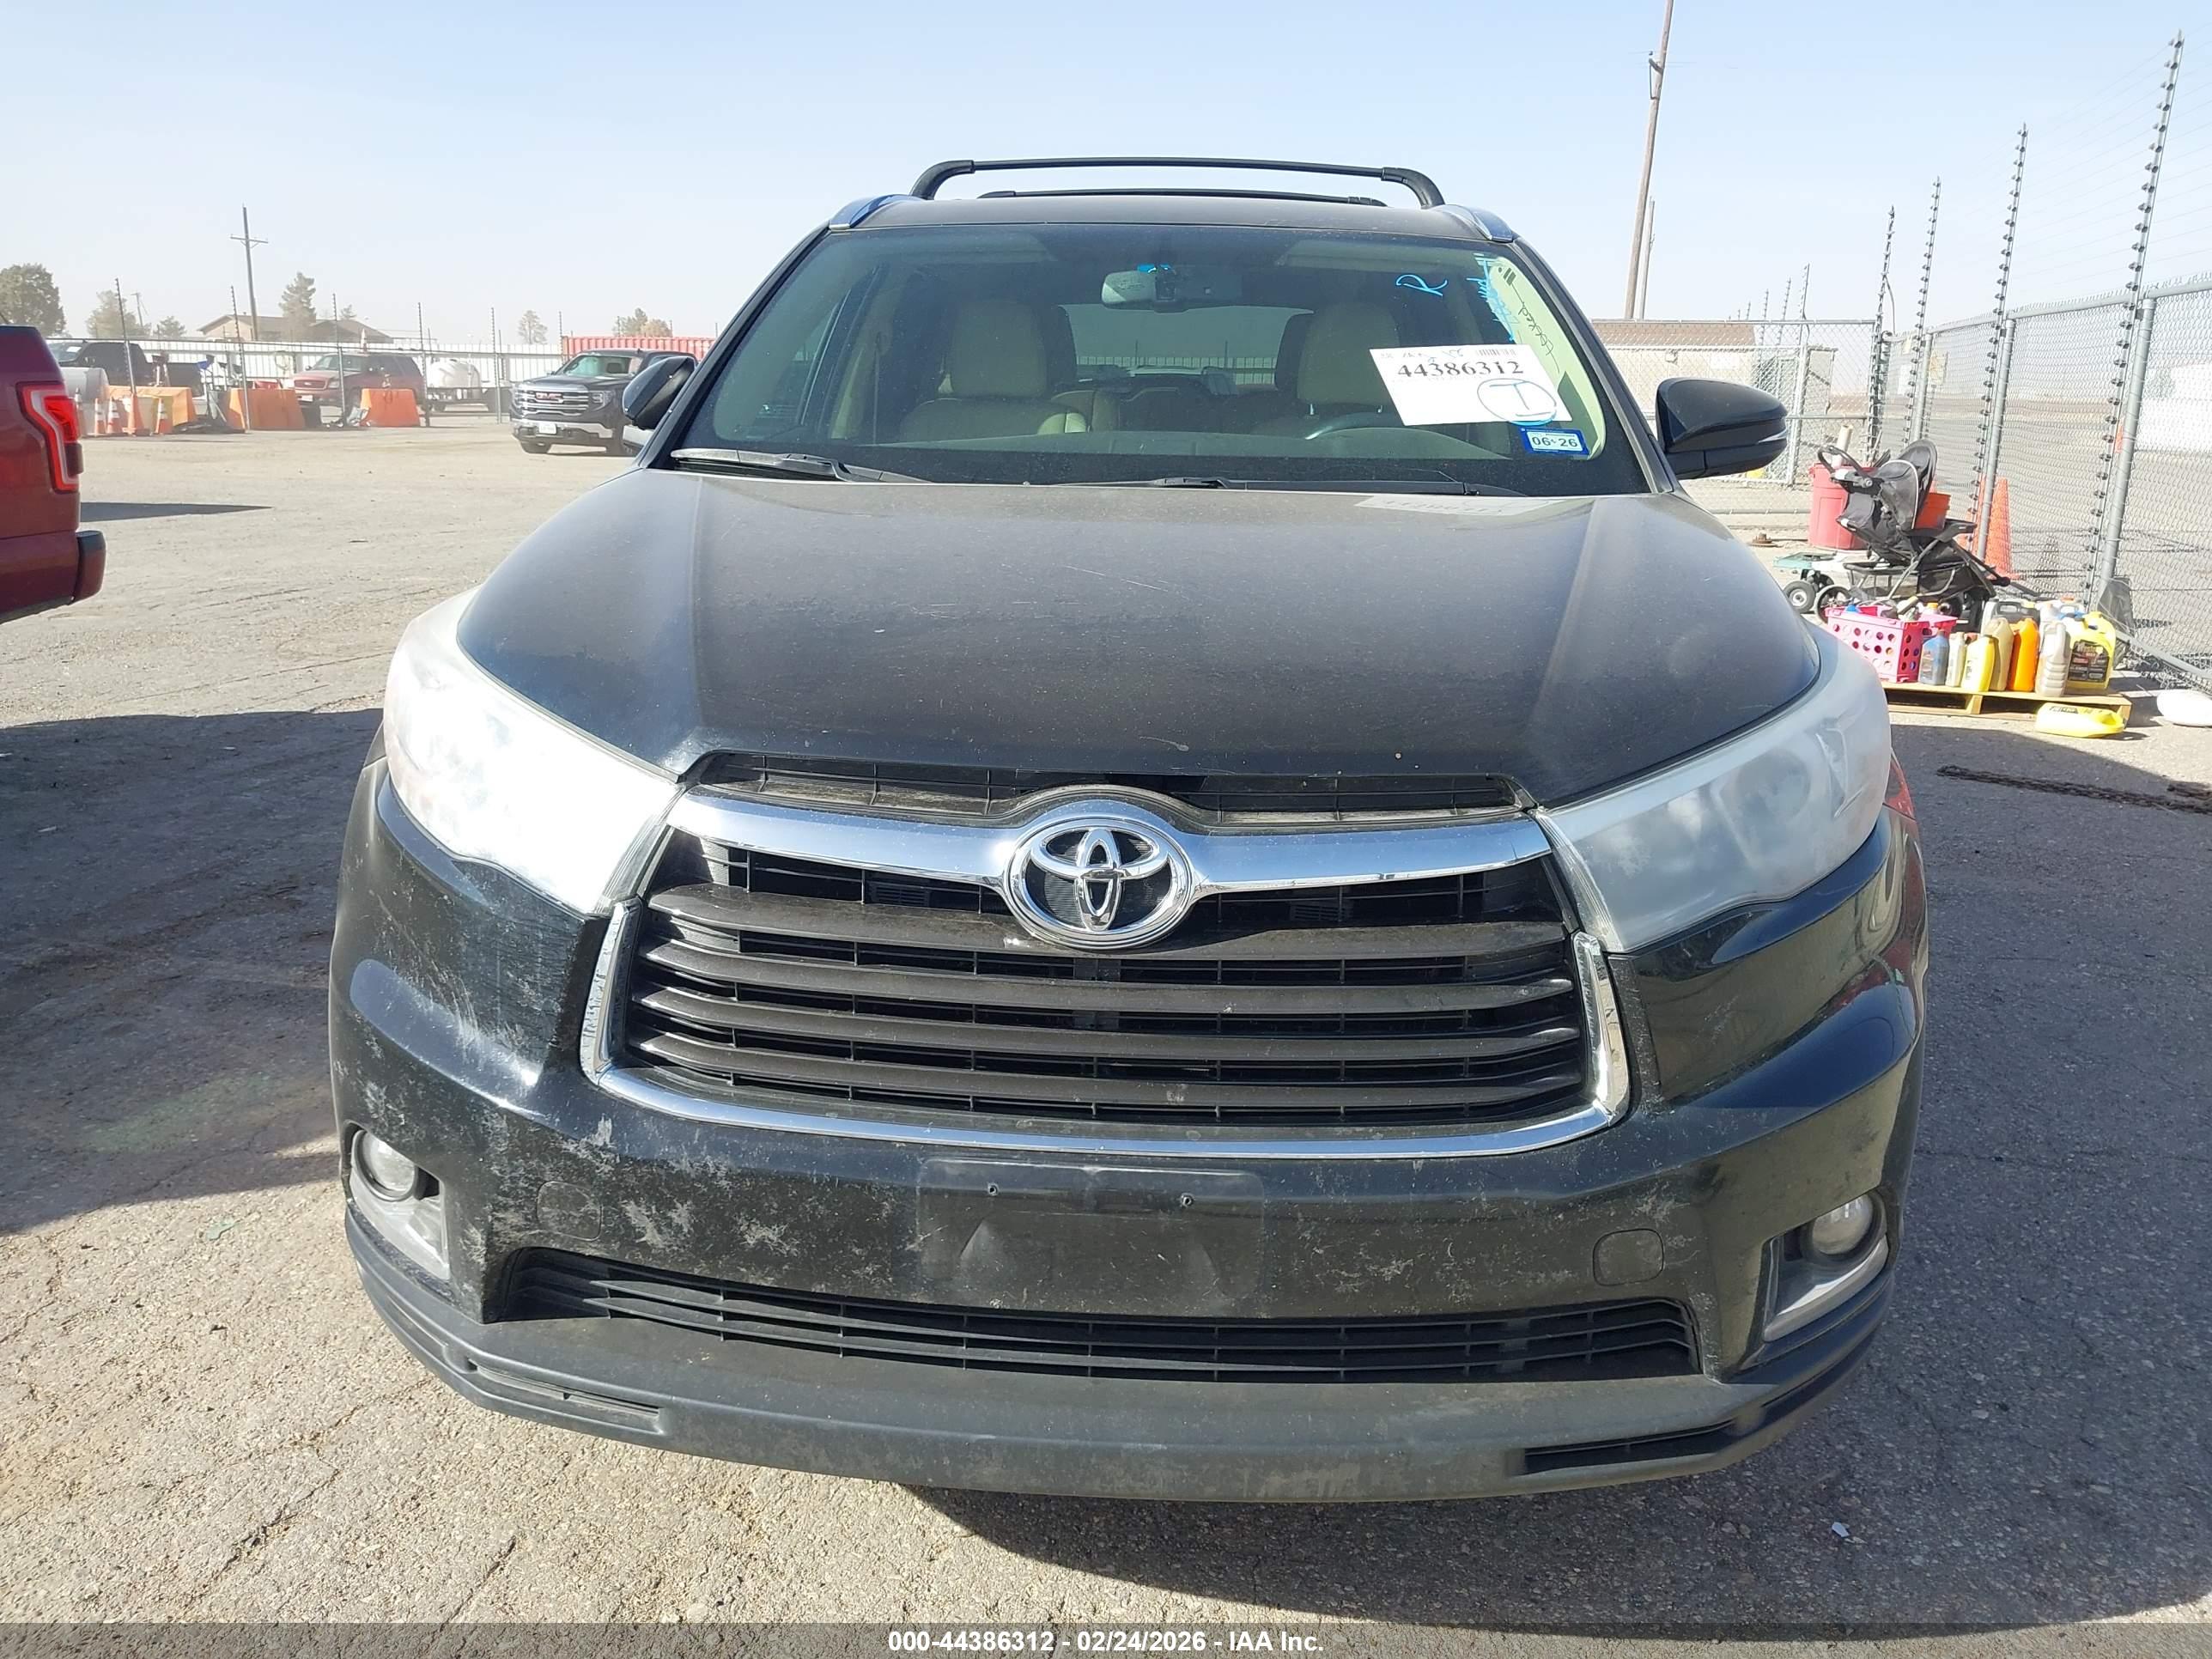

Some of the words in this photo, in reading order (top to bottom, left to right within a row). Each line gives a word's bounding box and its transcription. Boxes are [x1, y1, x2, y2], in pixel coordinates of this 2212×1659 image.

[1397, 361, 1524, 378] 44386312
[1531, 436, 1552, 447] 06
[1558, 438, 1579, 447] 26
